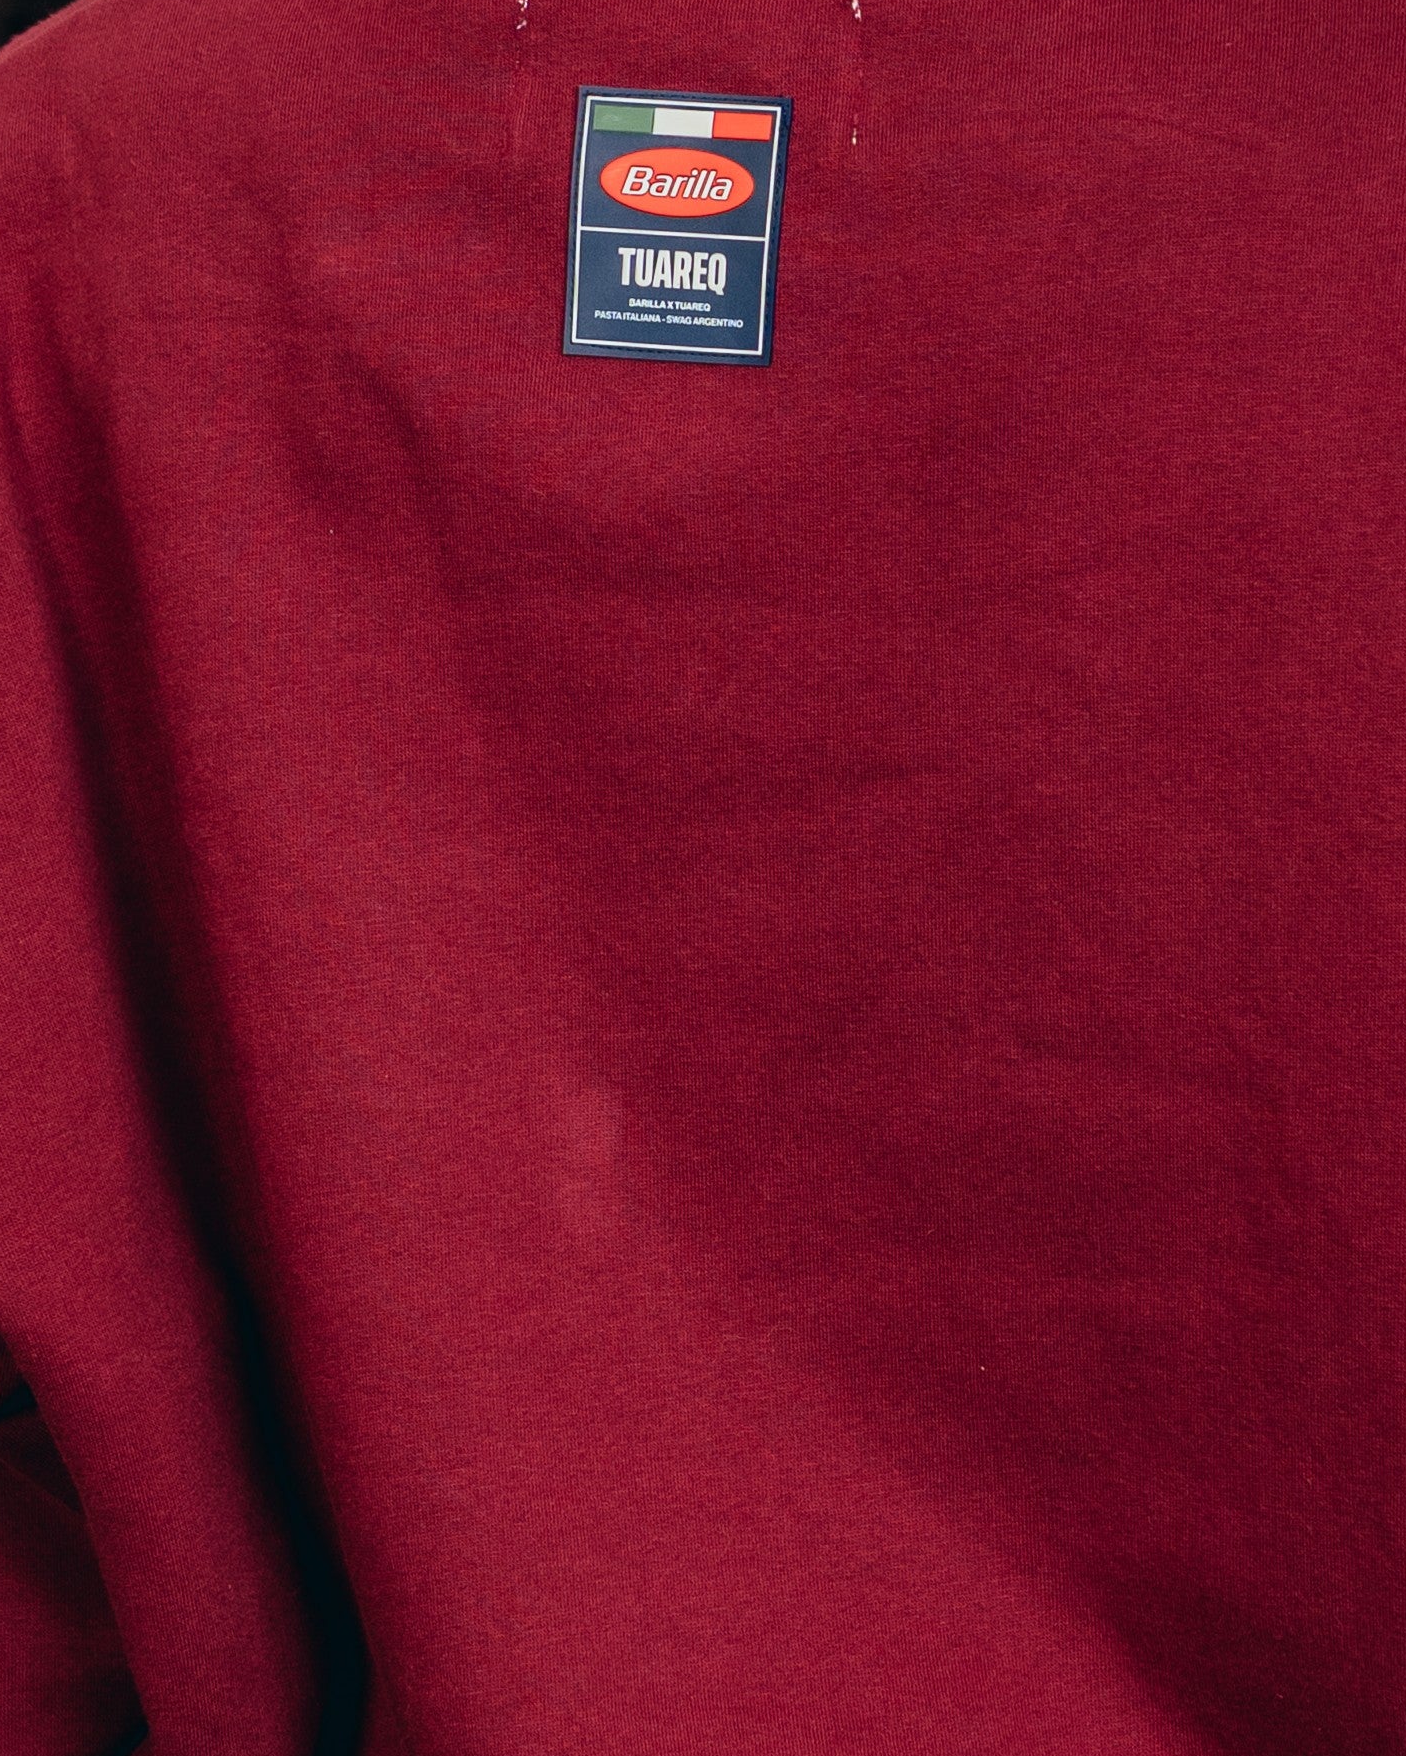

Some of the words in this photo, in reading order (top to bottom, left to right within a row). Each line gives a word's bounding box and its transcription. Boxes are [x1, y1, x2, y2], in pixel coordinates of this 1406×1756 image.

[621, 165, 734, 201] Barilla
[618, 247, 727, 295] TUAREQ
[628, 298, 666, 309] BARILLA
[666, 301, 674, 310] X
[675, 301, 711, 312] TUAREQ
[595, 310, 622, 320] PASTA
[622, 312, 661, 323] ITALIANA
[666, 315, 692, 325] SWAG
[693, 317, 743, 328] ARGENTINO
